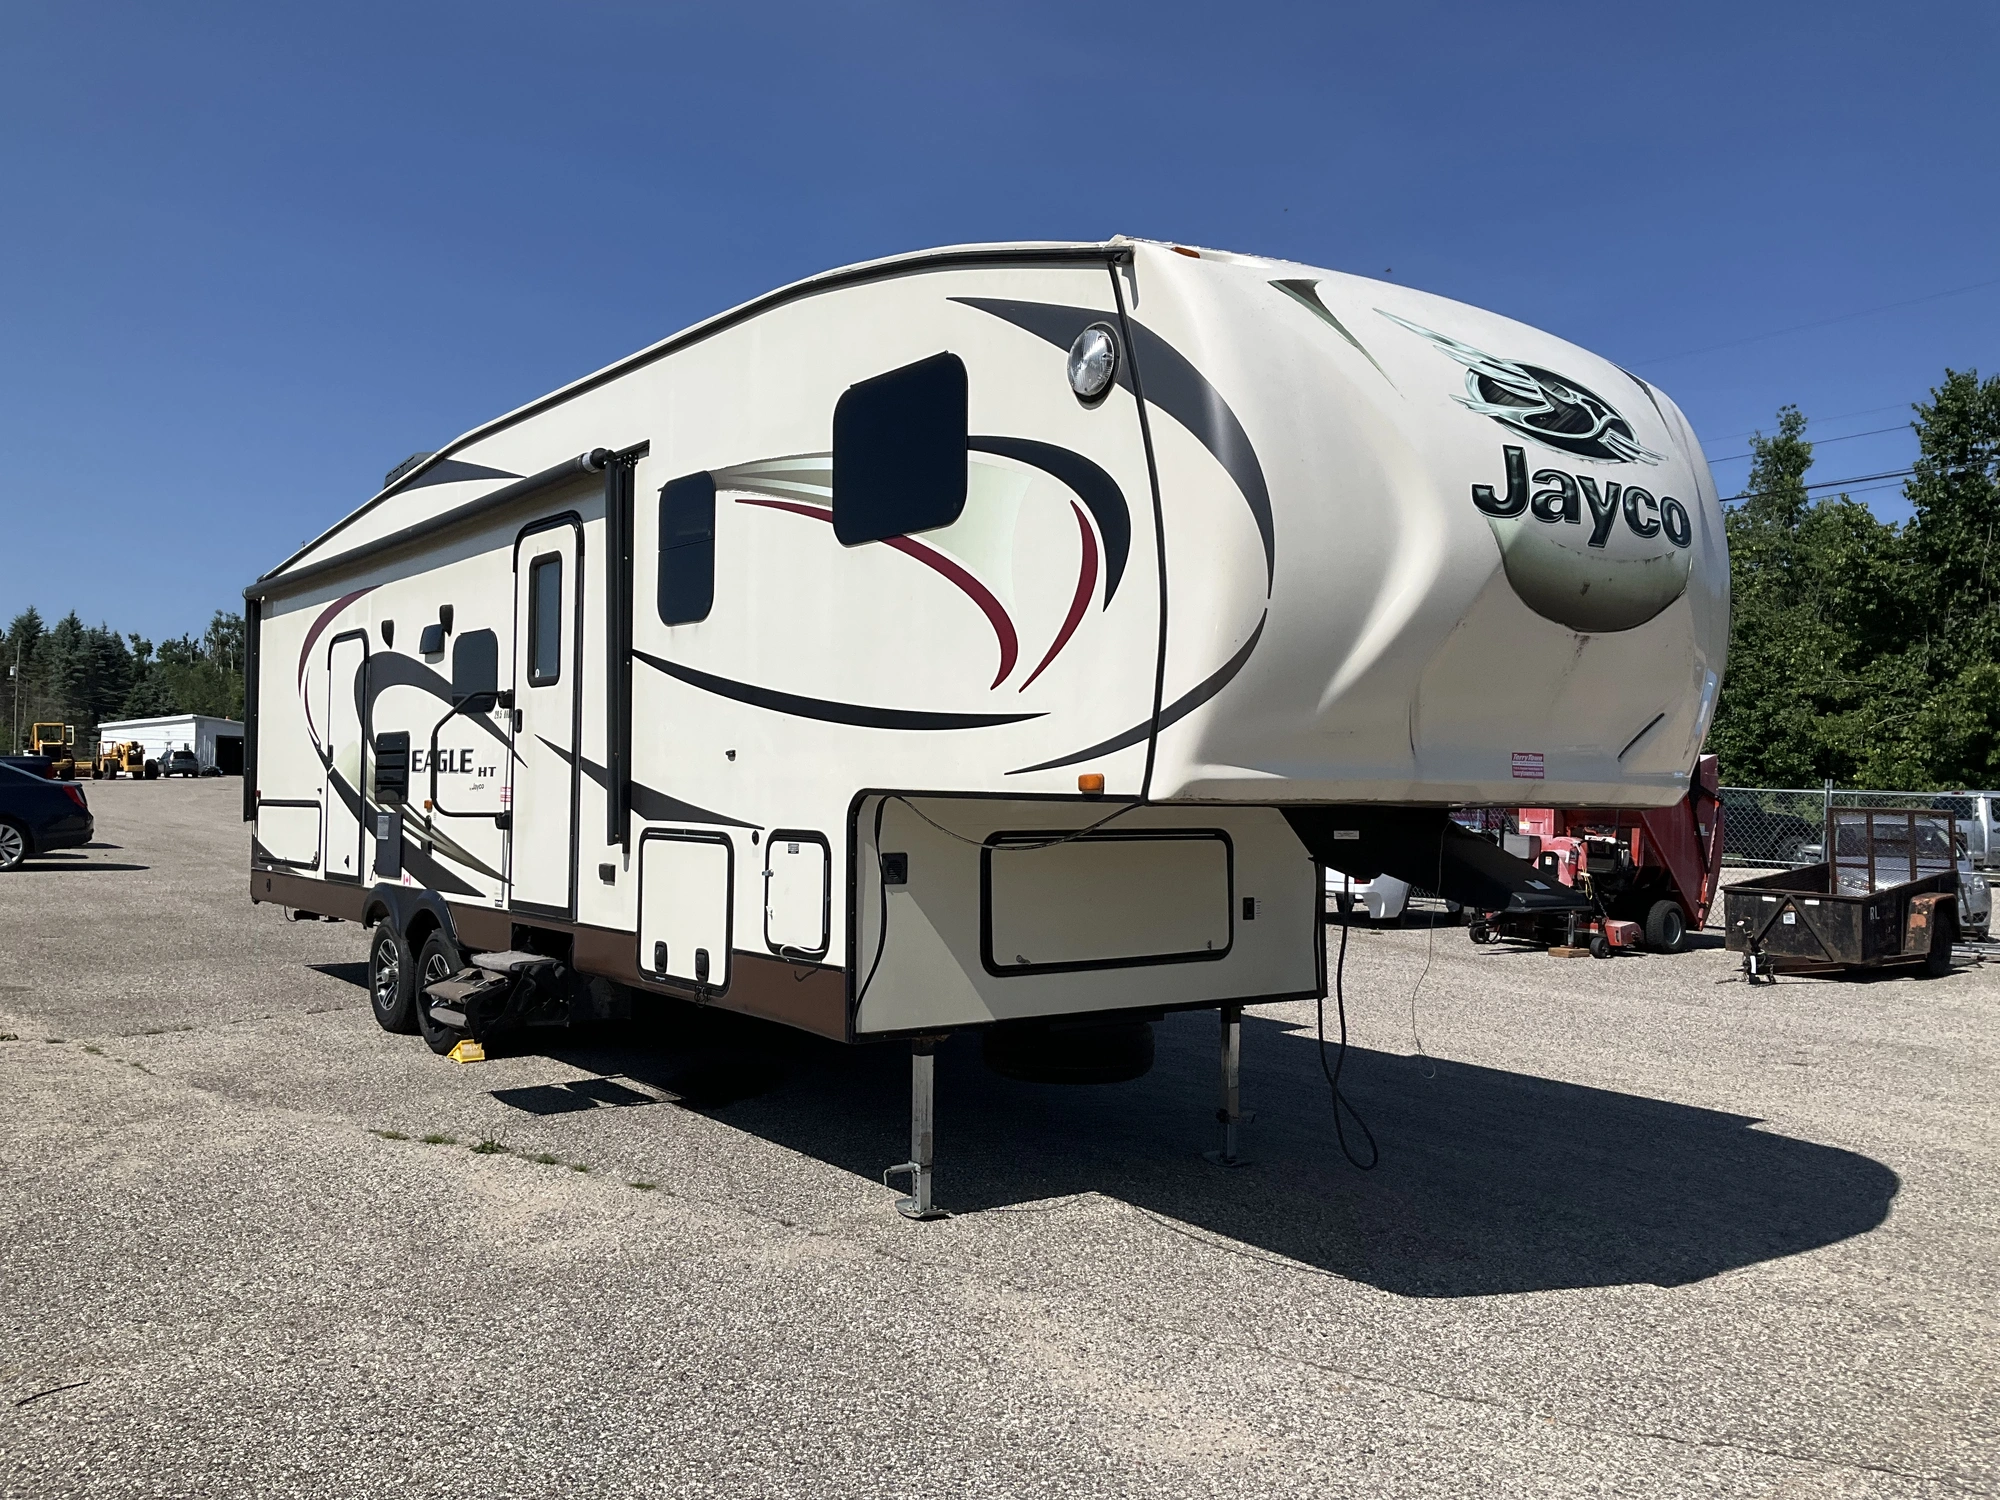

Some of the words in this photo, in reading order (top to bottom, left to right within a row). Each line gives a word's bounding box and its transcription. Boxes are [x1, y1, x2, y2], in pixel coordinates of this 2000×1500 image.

[1471, 443, 1693, 549] Jayco
[411, 748, 474, 774] EAGLE
[478, 767, 496, 777] HT
